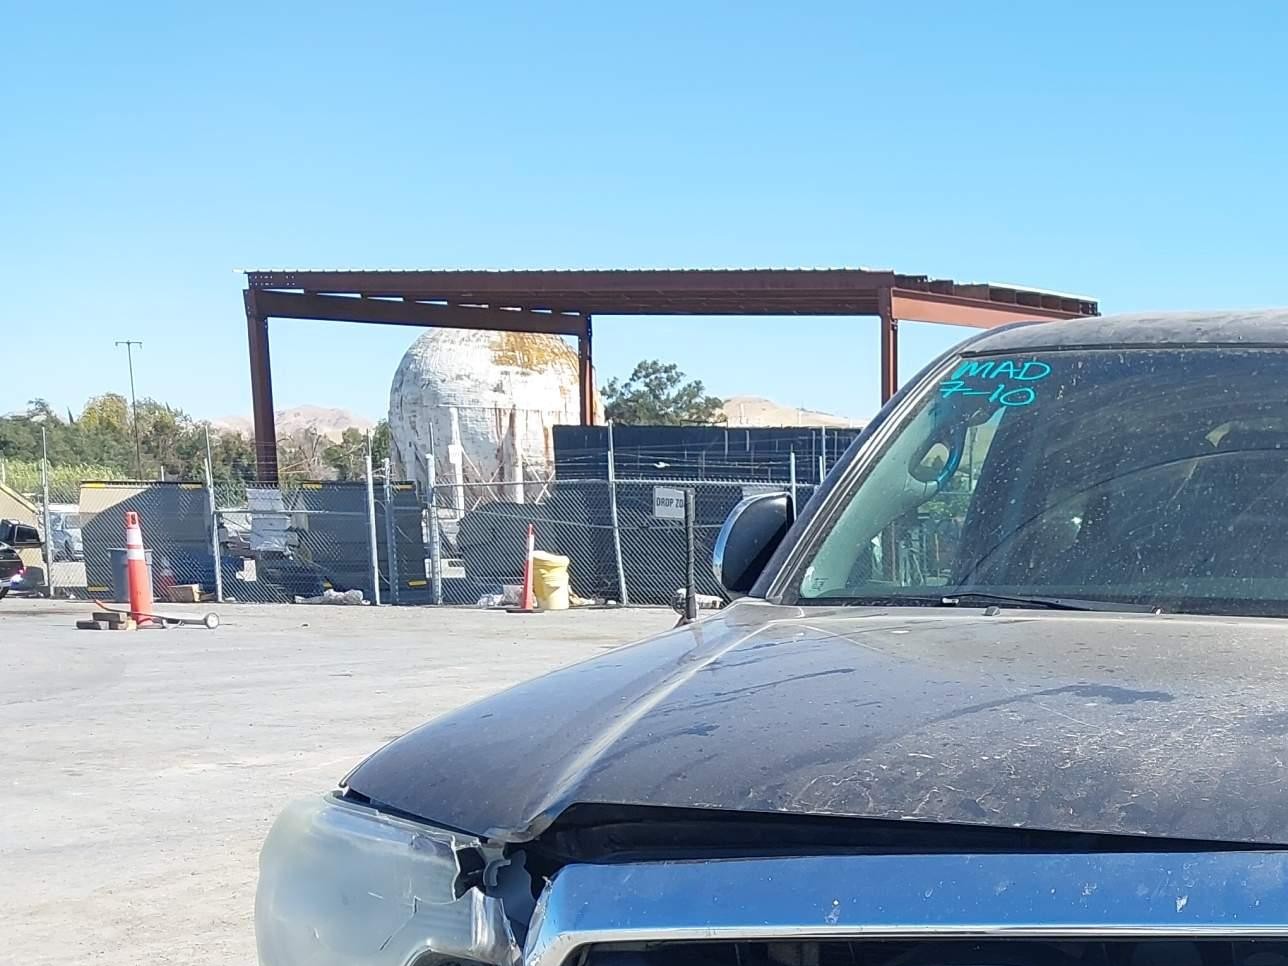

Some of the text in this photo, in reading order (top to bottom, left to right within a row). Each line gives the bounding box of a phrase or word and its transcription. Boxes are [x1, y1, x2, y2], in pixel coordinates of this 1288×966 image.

[951, 360, 1051, 380] MAD
[939, 380, 1036, 406] 7-10
[656, 497, 674, 508] DROP
